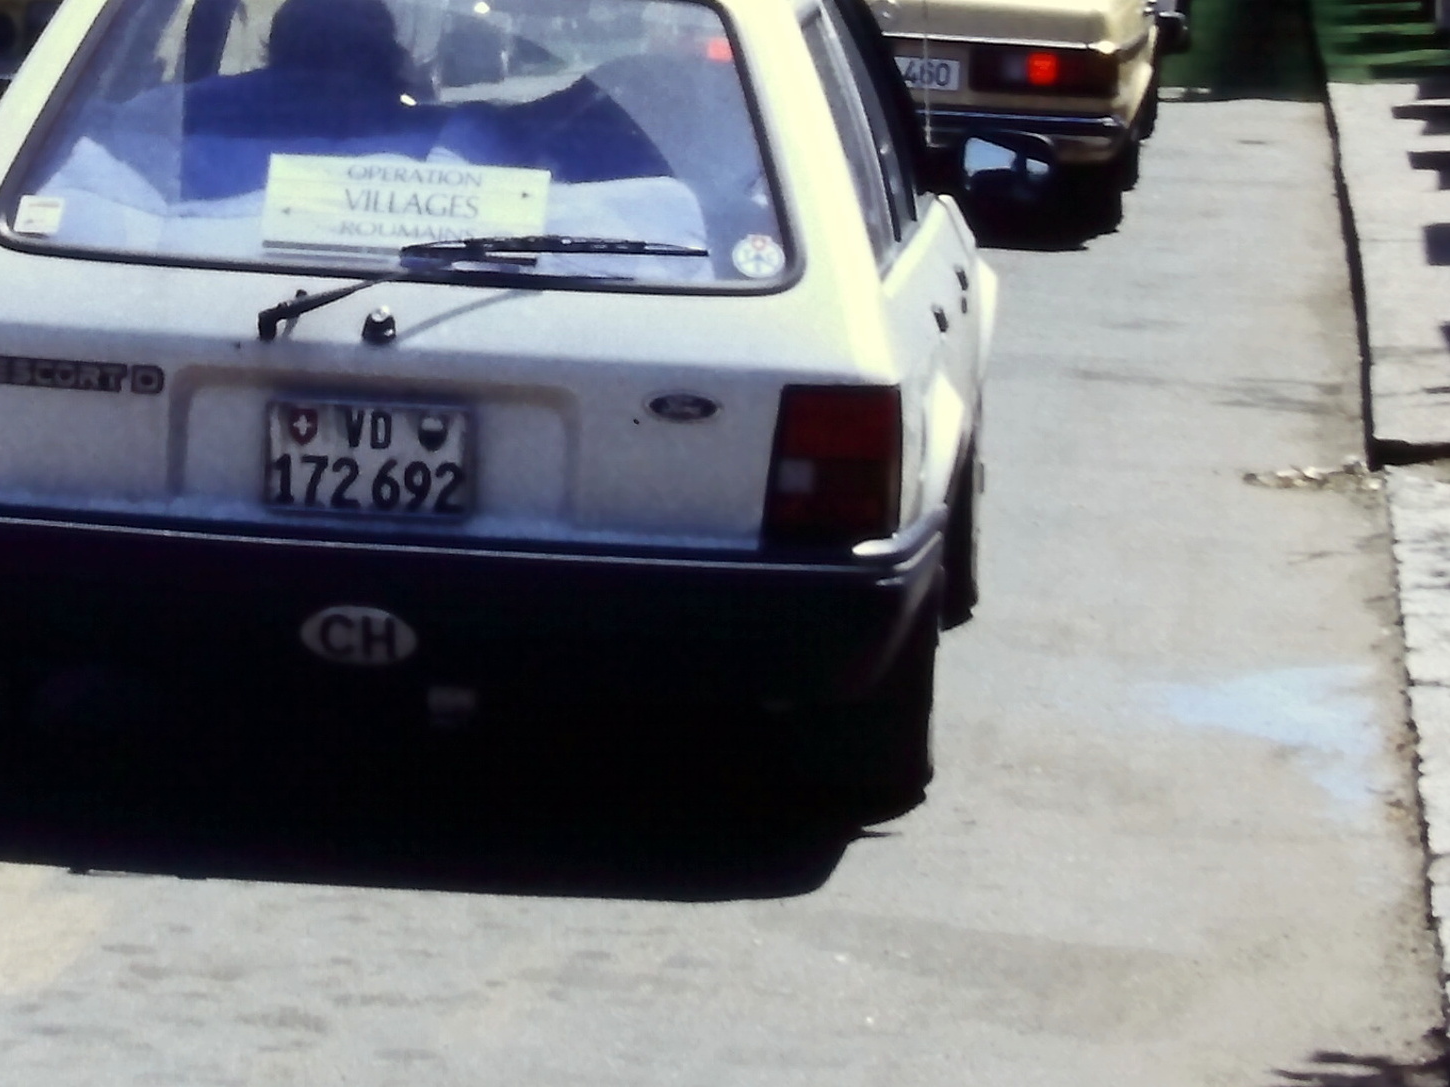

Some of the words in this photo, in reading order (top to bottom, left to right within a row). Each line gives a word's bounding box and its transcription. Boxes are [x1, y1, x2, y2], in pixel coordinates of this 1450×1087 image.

[348, 165, 482, 187] OPERATION
[345, 188, 480, 219] VILLAGES
[347, 411, 393, 449] VD
[319, 613, 397, 660] CH
